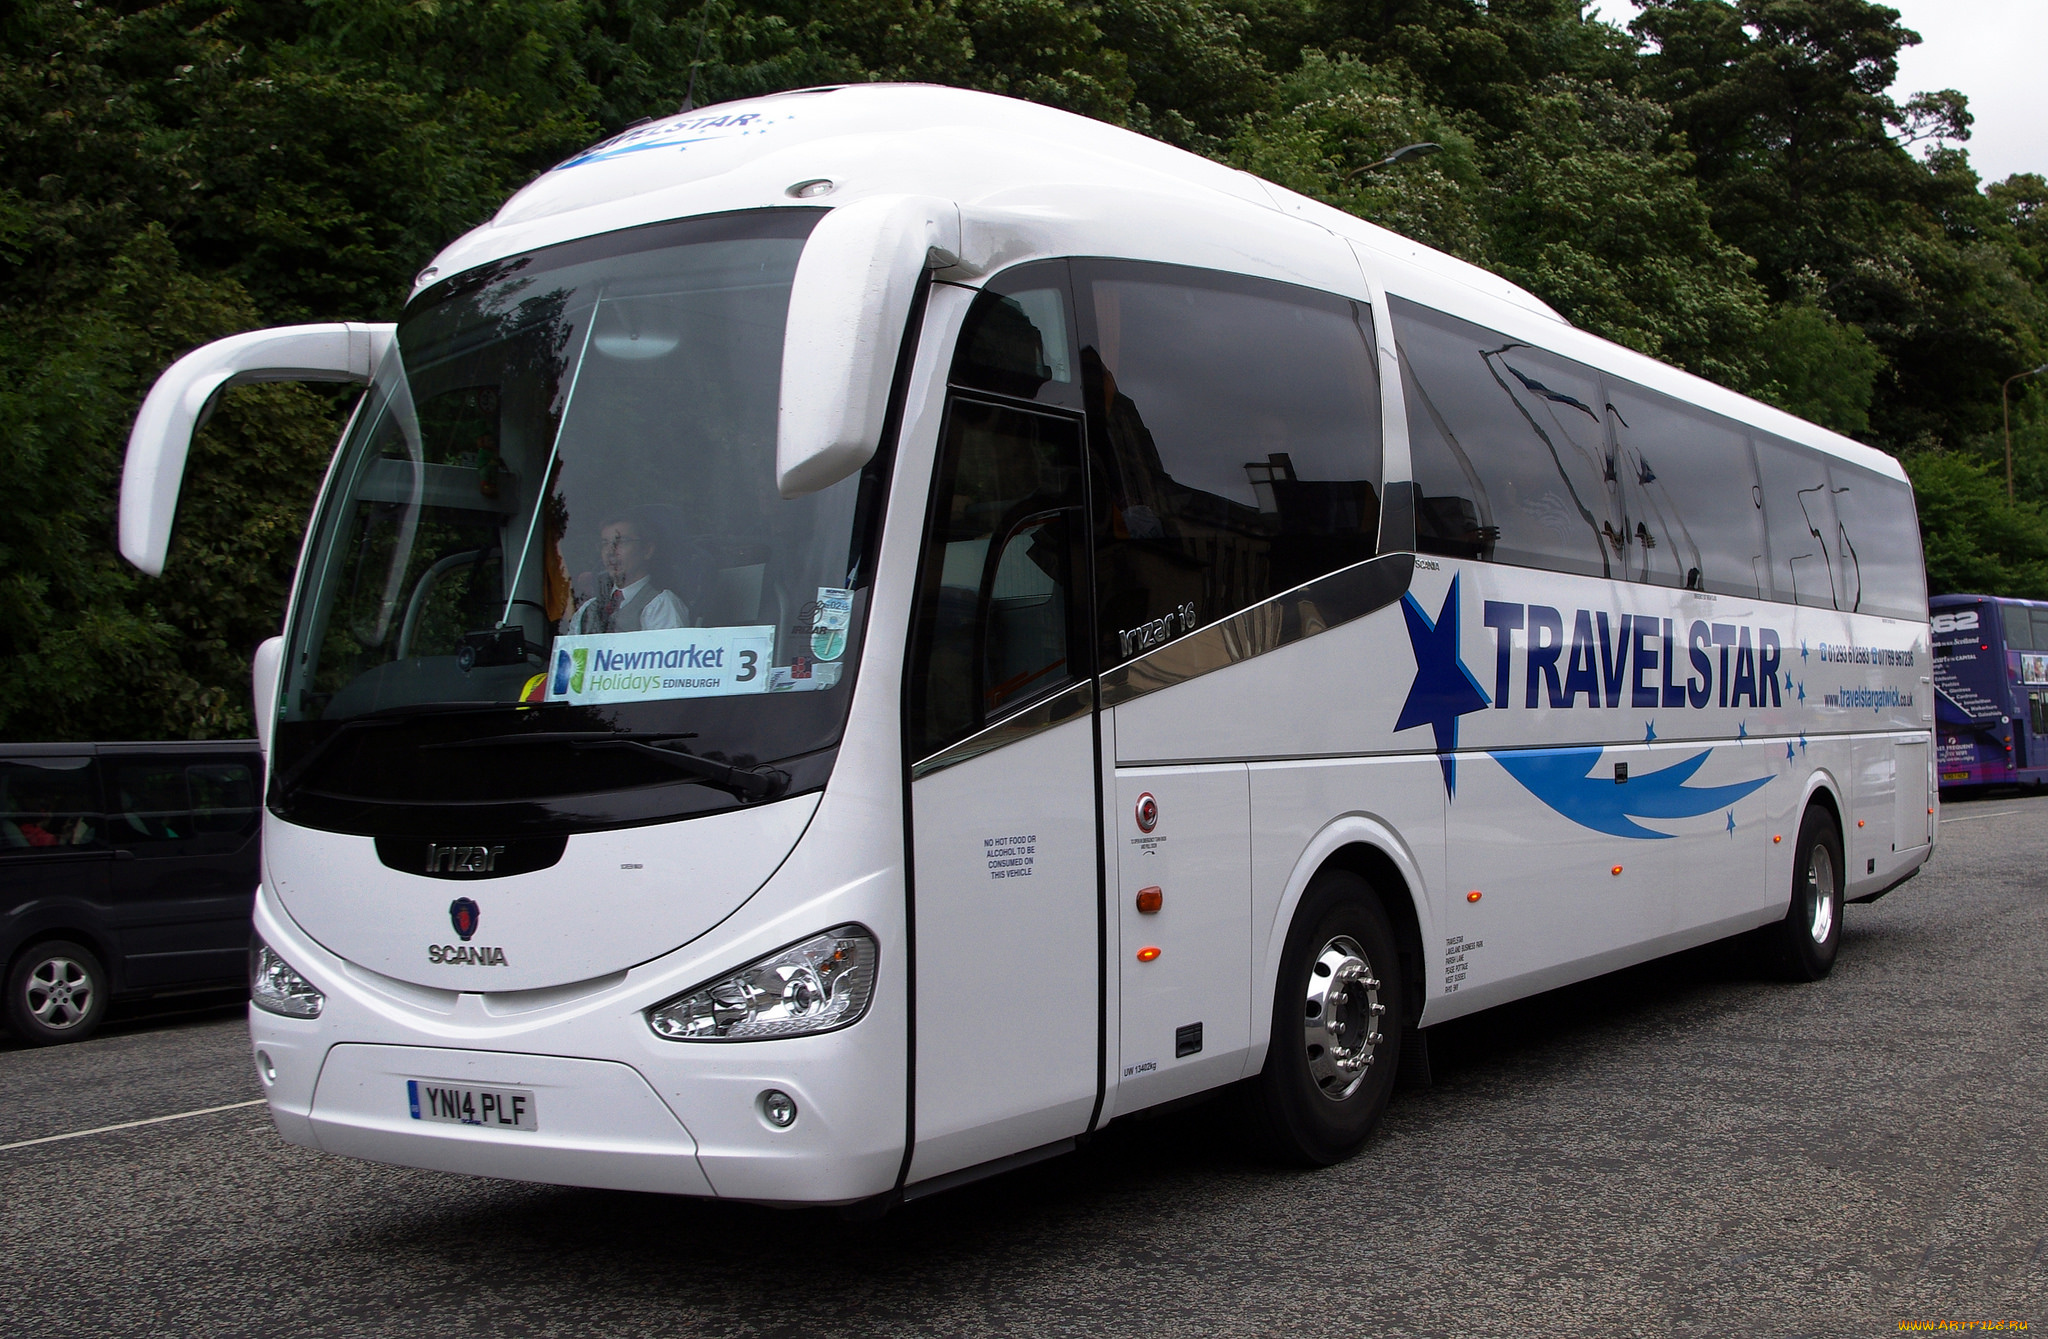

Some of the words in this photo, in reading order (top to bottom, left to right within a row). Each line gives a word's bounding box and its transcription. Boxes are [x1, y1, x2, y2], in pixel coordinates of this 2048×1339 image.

[1414, 559, 1440, 571] SCANIA
[1177, 601, 1196, 633] i6
[593, 644, 724, 672] Newmarket
[735, 650, 759, 682] 3
[1484, 600, 1782, 709] TRAVELSTAR
[589, 673, 661, 693] Holidays
[662, 678, 720, 689] EDINBURGH
[1824, 686, 1913, 713] www.travelstargatwick.co.uk
[984, 839, 994, 847] NO
[995, 837, 1008, 846] HOT
[1009, 836, 1026, 845] FOOD
[987, 848, 1016, 858] ALCOHOL
[1017, 847, 1026, 855] TO
[1027, 846, 1035, 854] BE
[988, 858, 1023, 869] CONSUMED
[991, 870, 1005, 879] THIS
[1006, 867, 1032, 878] VEHICLE
[428, 944, 510, 967] SCANIA
[426, 1087, 475, 1121] YN14
[481, 1093, 526, 1125] PLF
